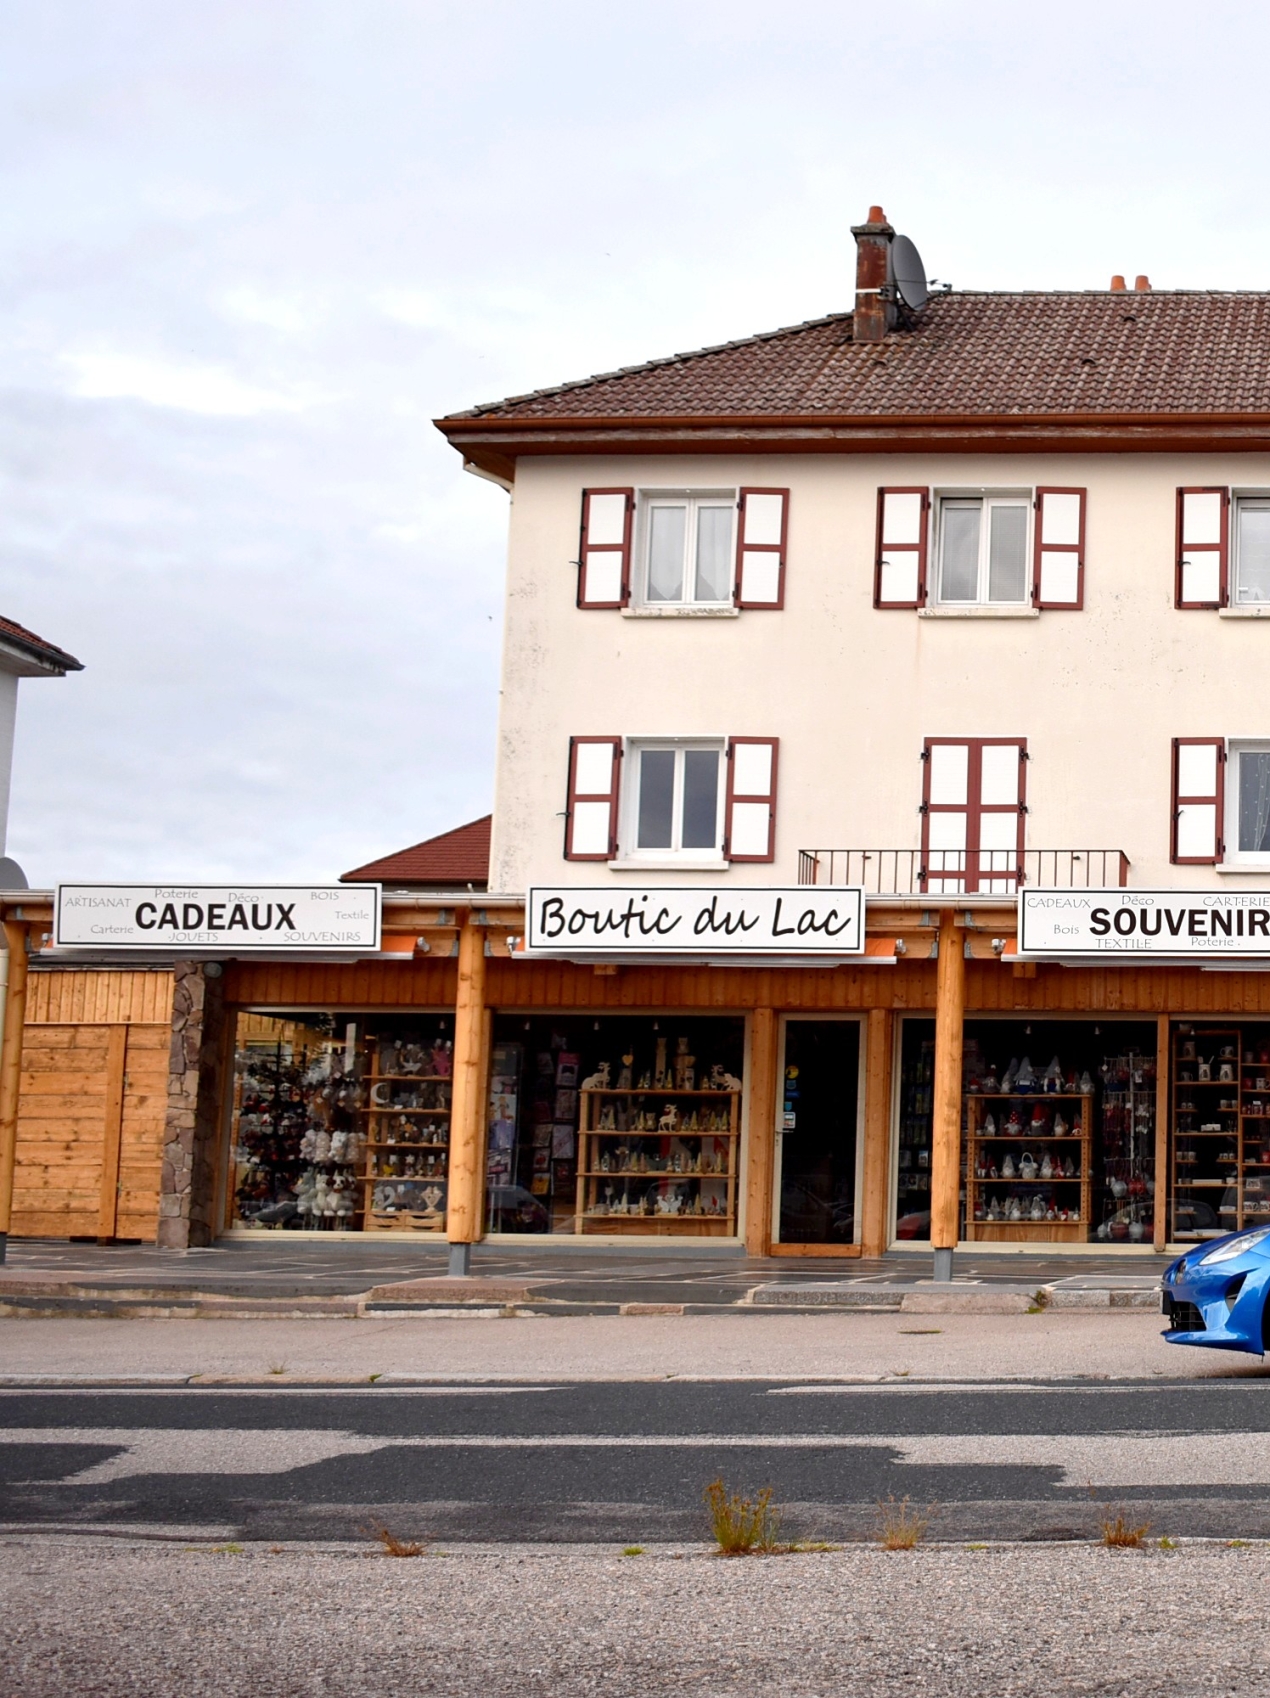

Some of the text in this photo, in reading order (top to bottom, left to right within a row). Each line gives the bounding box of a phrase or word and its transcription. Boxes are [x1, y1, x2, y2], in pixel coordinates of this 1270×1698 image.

[154, 888, 199, 900] Poterie
[310, 891, 340, 901] BOIS
[64, 896, 132, 908] ARTISANAT
[1026, 897, 1091, 909] CADEAUX
[1202, 896, 1270, 907] CARTERIE
[135, 902, 296, 931] CADEAUX
[334, 910, 370, 921] Textile
[540, 895, 851, 938] Boutic du Lac
[90, 923, 134, 935] Carterie
[1053, 923, 1081, 935] Bois
[170, 931, 219, 942] JOUETS
[283, 931, 362, 942] SOUVENIRS
[1191, 936, 1235, 947] Poterie
[1095, 938, 1153, 949] TEXTILE
